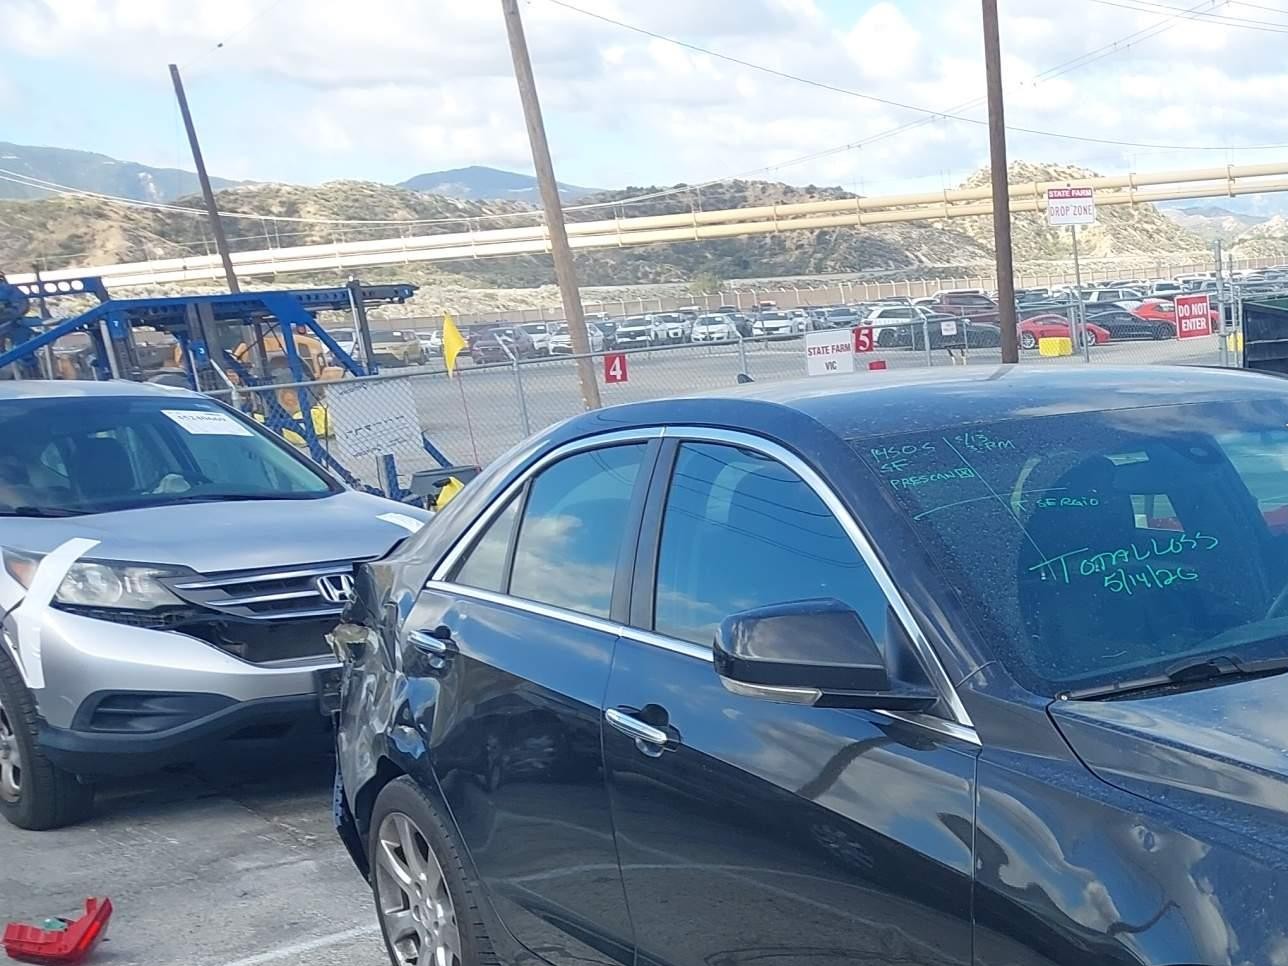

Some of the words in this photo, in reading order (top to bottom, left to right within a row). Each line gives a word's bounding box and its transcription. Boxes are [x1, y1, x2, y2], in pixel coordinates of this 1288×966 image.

[1050, 190, 1070, 198] STATE
[1071, 189, 1091, 197] FARM
[1050, 206, 1070, 217] DROP
[1073, 204, 1092, 216] ZONE
[1178, 304, 1190, 317] DO
[1191, 302, 1208, 316] NOT
[1181, 317, 1208, 331] ENTER
[859, 328, 870, 351] 5
[807, 345, 831, 357] STATE
[831, 342, 851, 354] FARM
[609, 356, 623, 380] 4
[824, 361, 838, 370] VIC
[880, 458, 910, 474] SF
[1103, 564, 1199, 595] 5/14/26
